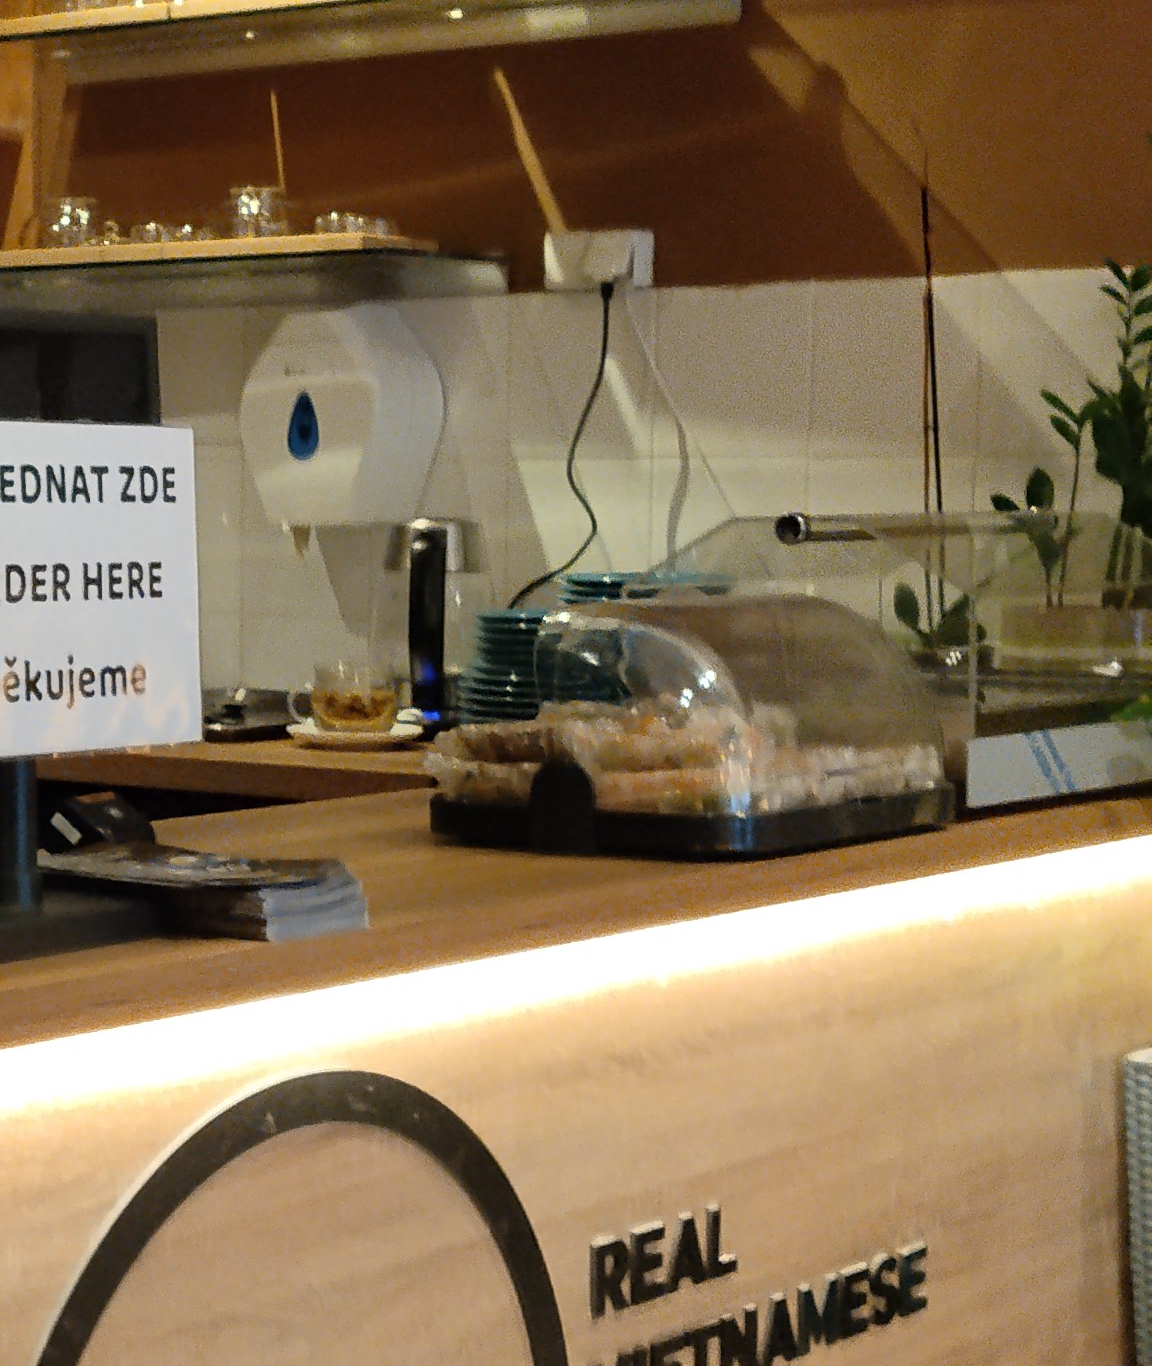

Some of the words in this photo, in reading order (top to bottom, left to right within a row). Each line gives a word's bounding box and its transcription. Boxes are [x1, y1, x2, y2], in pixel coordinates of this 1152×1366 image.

[118, 465, 177, 504] ZDE
[82, 561, 163, 601] HERE
[589, 1202, 737, 1323] REAL
